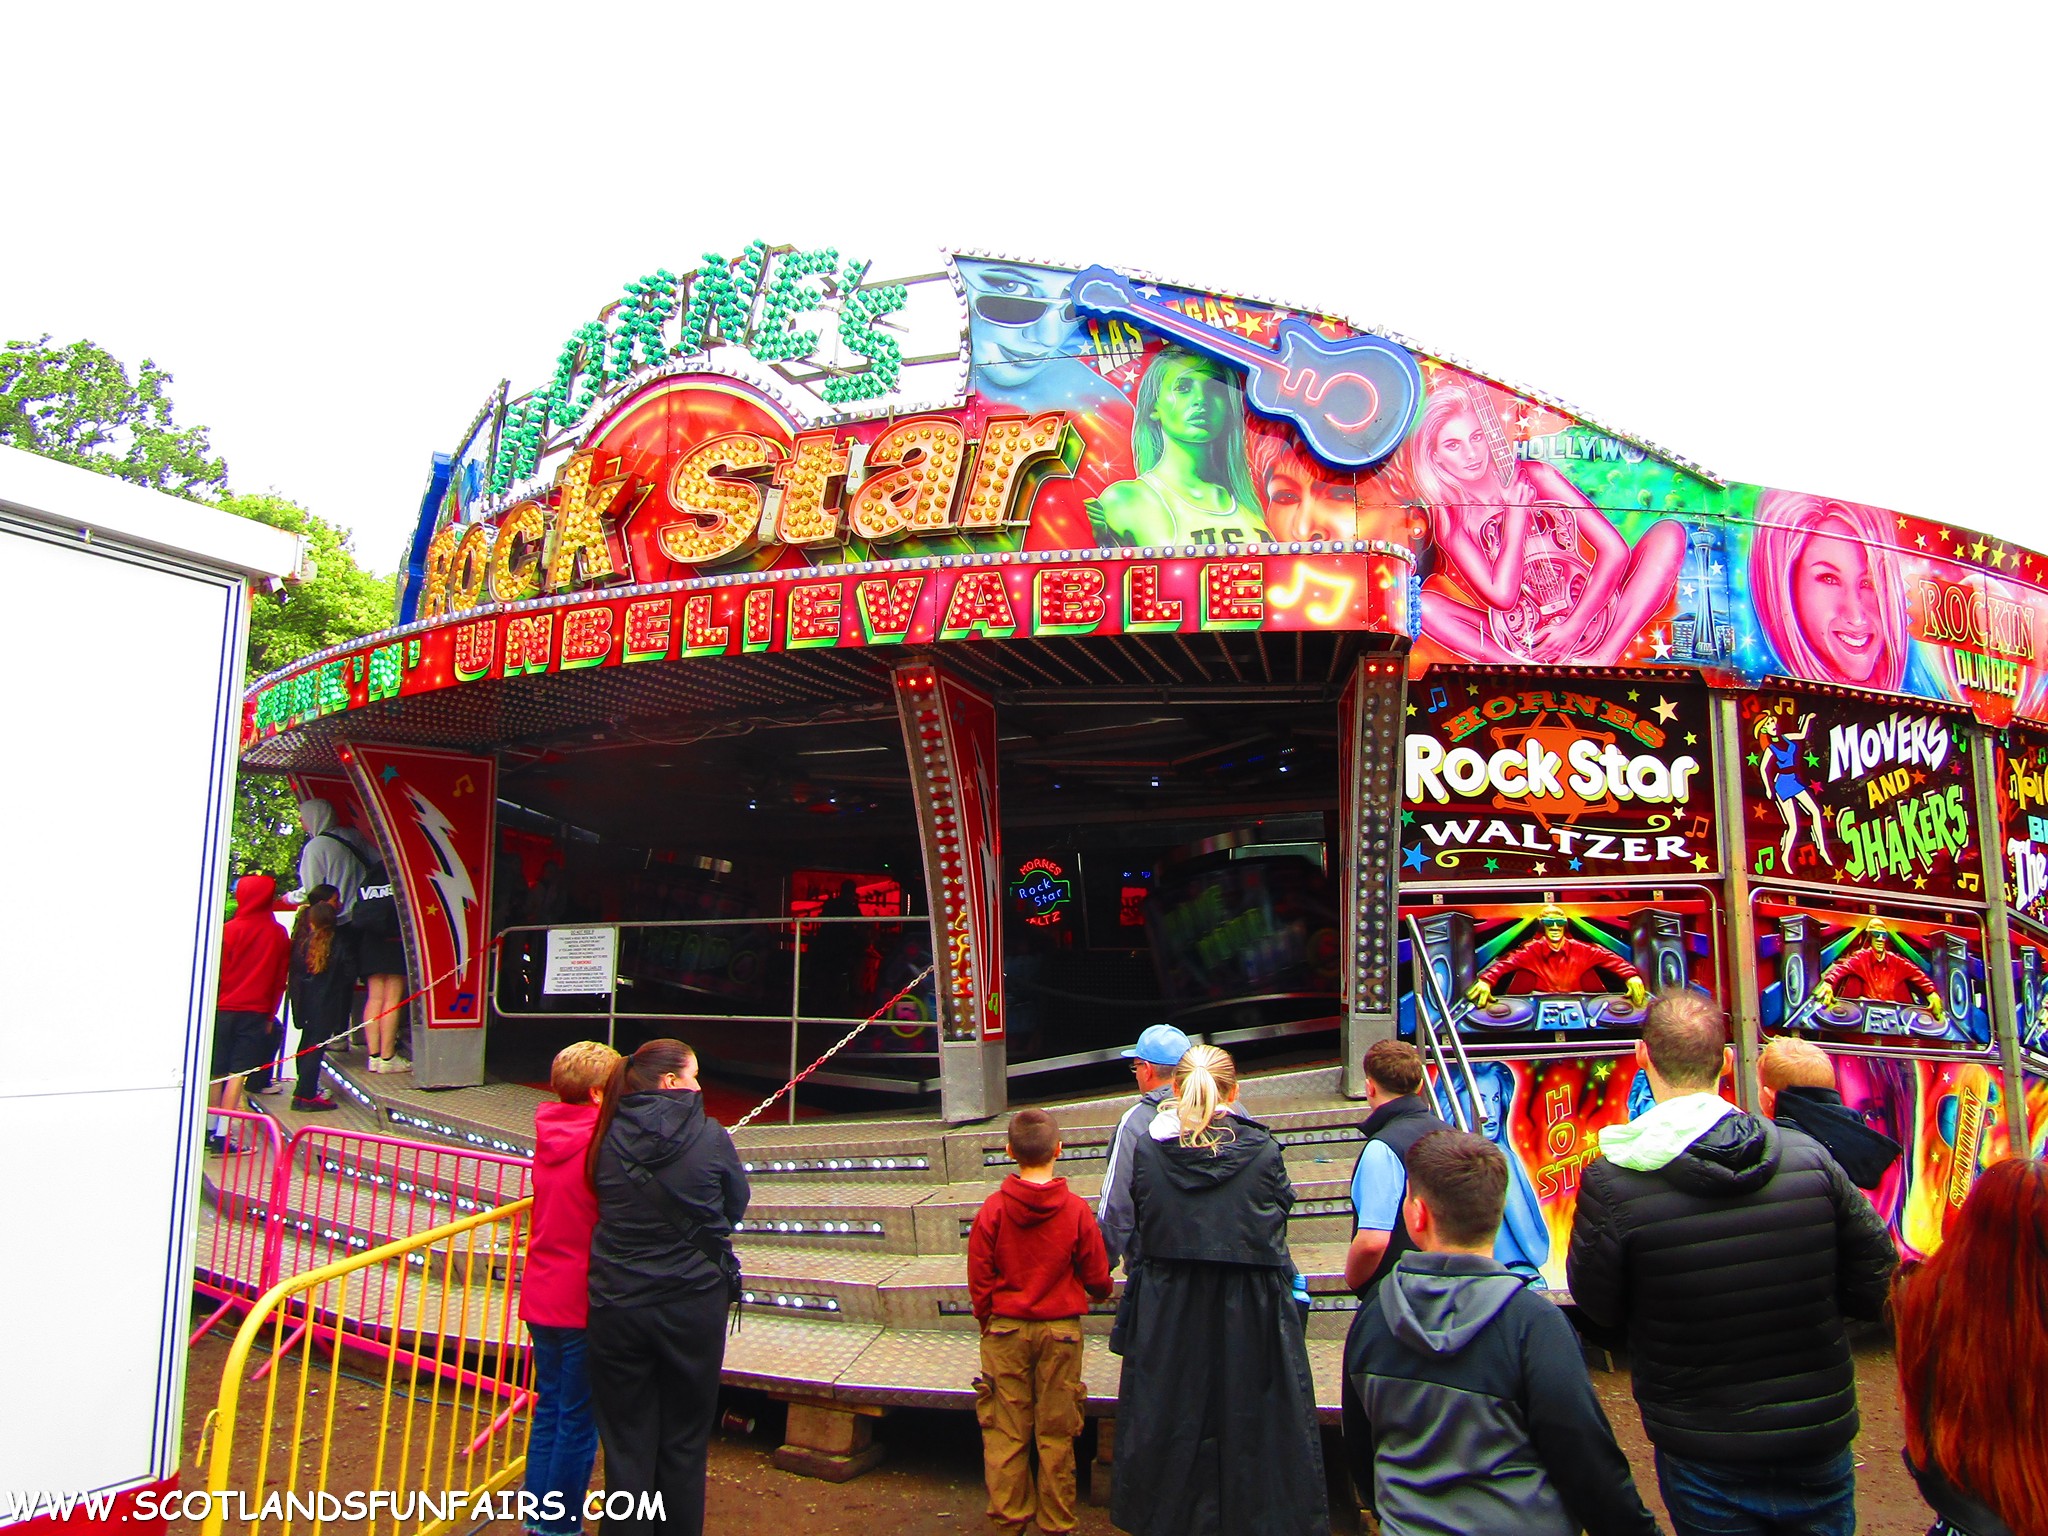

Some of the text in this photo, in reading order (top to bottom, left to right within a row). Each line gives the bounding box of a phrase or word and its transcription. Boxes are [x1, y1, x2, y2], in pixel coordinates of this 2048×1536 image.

[1087, 293, 1240, 376] LAS GAS
[658, 410, 1072, 564] Star
[453, 562, 1264, 682] UNBELIEVABLE
[1919, 579, 2036, 660] ROCKIN
[1954, 649, 2020, 697] DUNDEE
[1441, 690, 1667, 748] HORNES
[1827, 713, 1949, 783] MOVERS
[1405, 734, 1700, 804] Rock Star
[1867, 767, 1911, 810] AND
[1421, 819, 1692, 862] WALTZER
[1841, 786, 1969, 880] SHAKERS
[1019, 878, 1051, 898] Rock
[1034, 888, 1062, 907] Star
